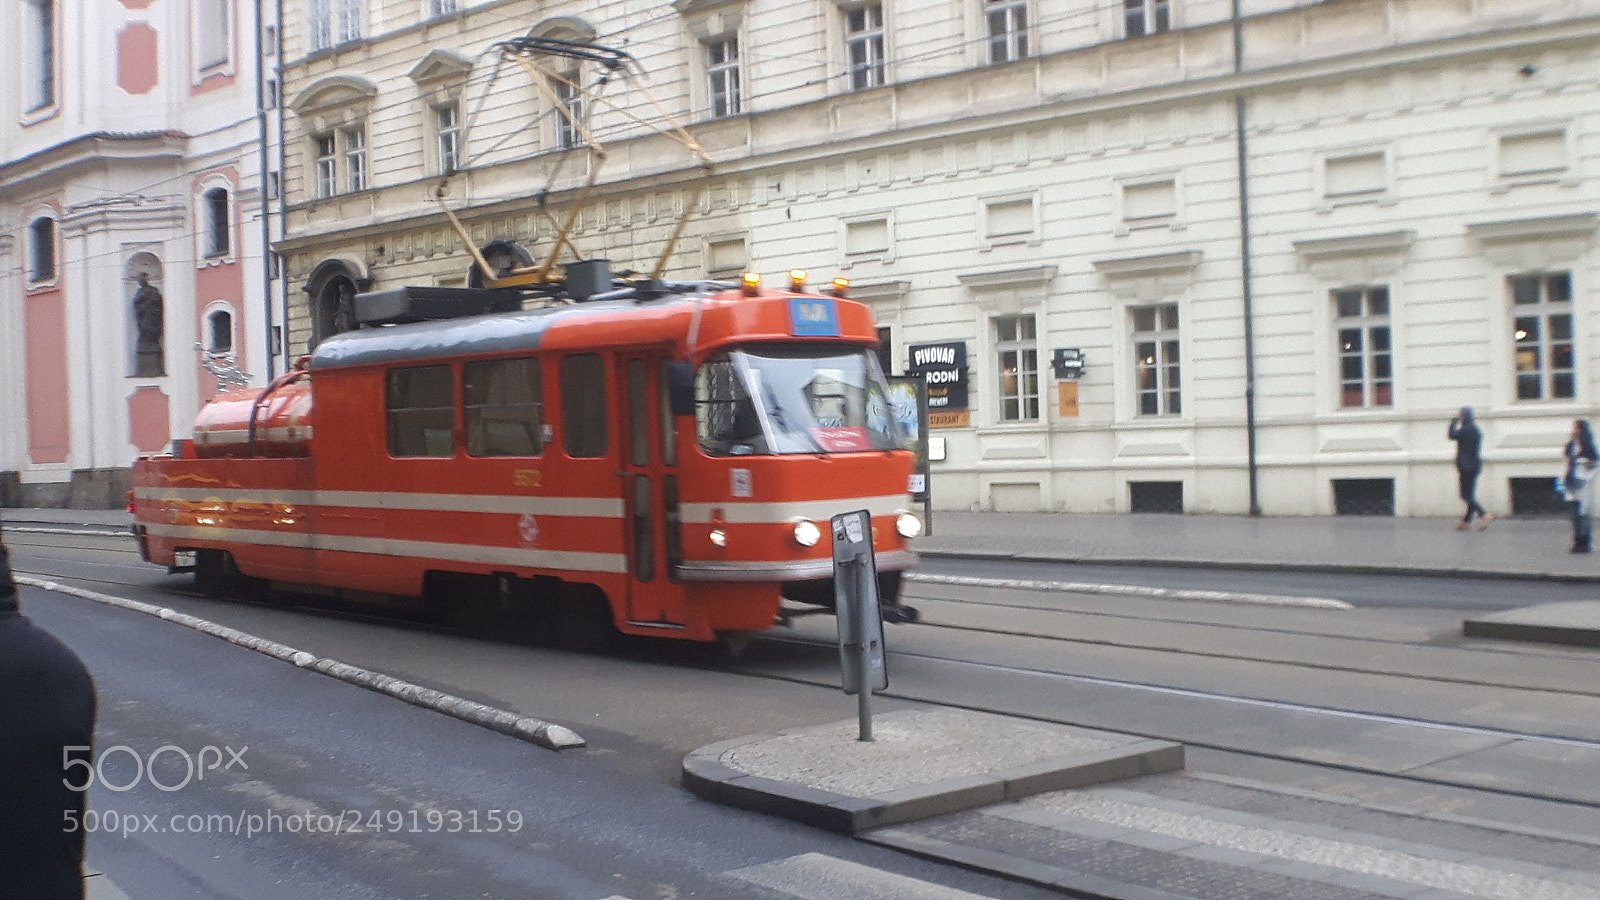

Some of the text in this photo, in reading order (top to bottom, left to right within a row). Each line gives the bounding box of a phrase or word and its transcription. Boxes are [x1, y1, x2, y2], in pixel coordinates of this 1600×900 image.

[914, 346, 956, 367] PIVOVAR
[911, 367, 959, 384] RODNÍ
[929, 414, 960, 426] STAURANT
